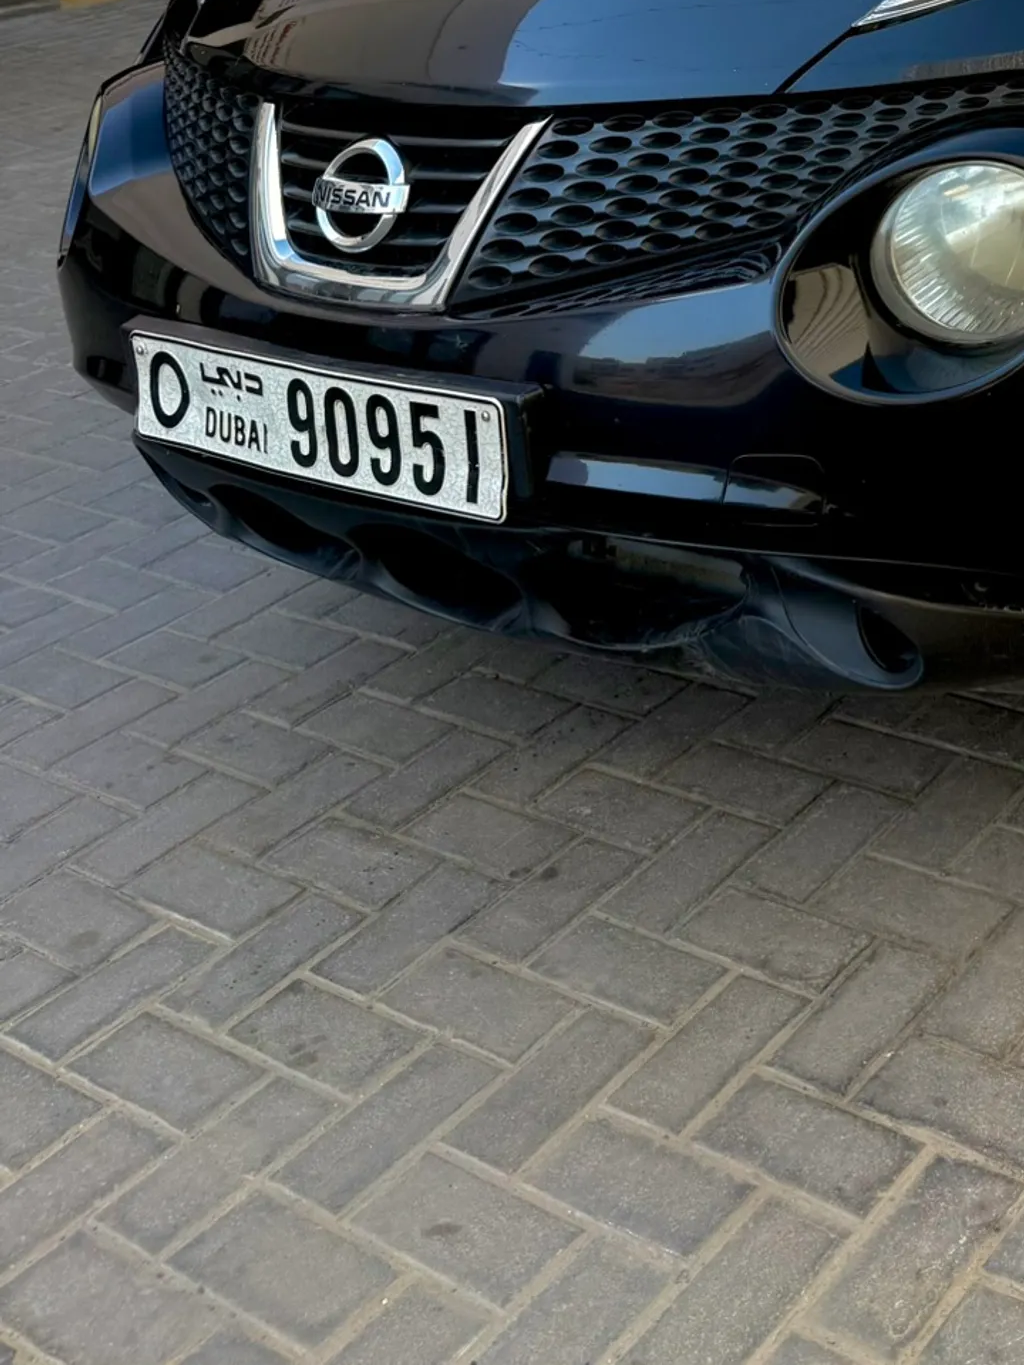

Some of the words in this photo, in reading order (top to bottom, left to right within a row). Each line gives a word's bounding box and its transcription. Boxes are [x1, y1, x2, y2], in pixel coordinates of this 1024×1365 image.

[315, 179, 391, 209] NISSAN
[199, 362, 264, 402] دبي
[205, 406, 269, 454] DUBAI
[286, 378, 479, 505] 90951
